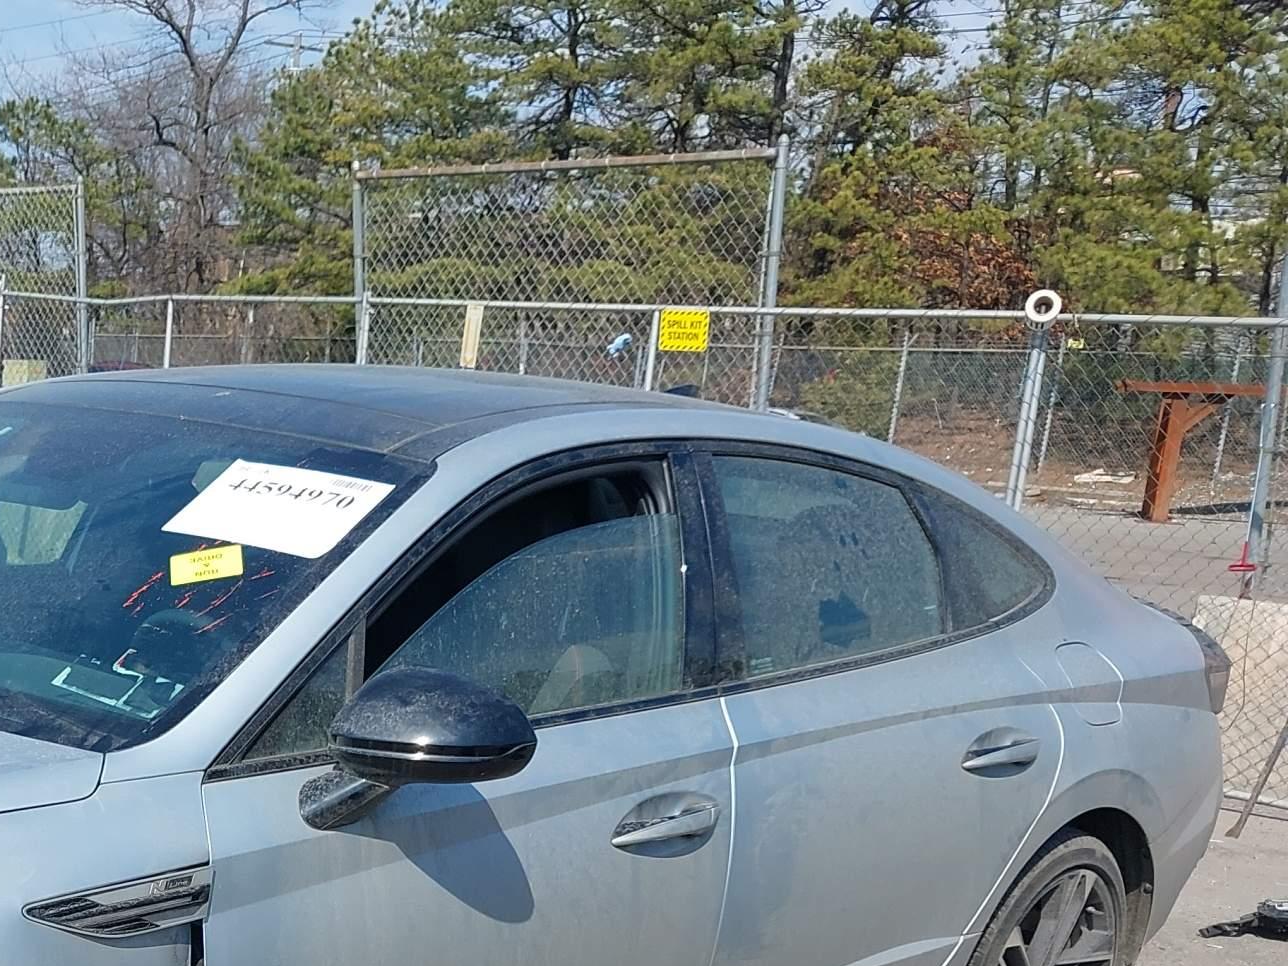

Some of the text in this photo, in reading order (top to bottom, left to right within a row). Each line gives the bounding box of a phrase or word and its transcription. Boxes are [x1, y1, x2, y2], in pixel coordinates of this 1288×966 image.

[667, 319, 703, 329] SPILL KIT
[667, 331, 699, 341] STATION
[228, 478, 356, 509] 44594970
